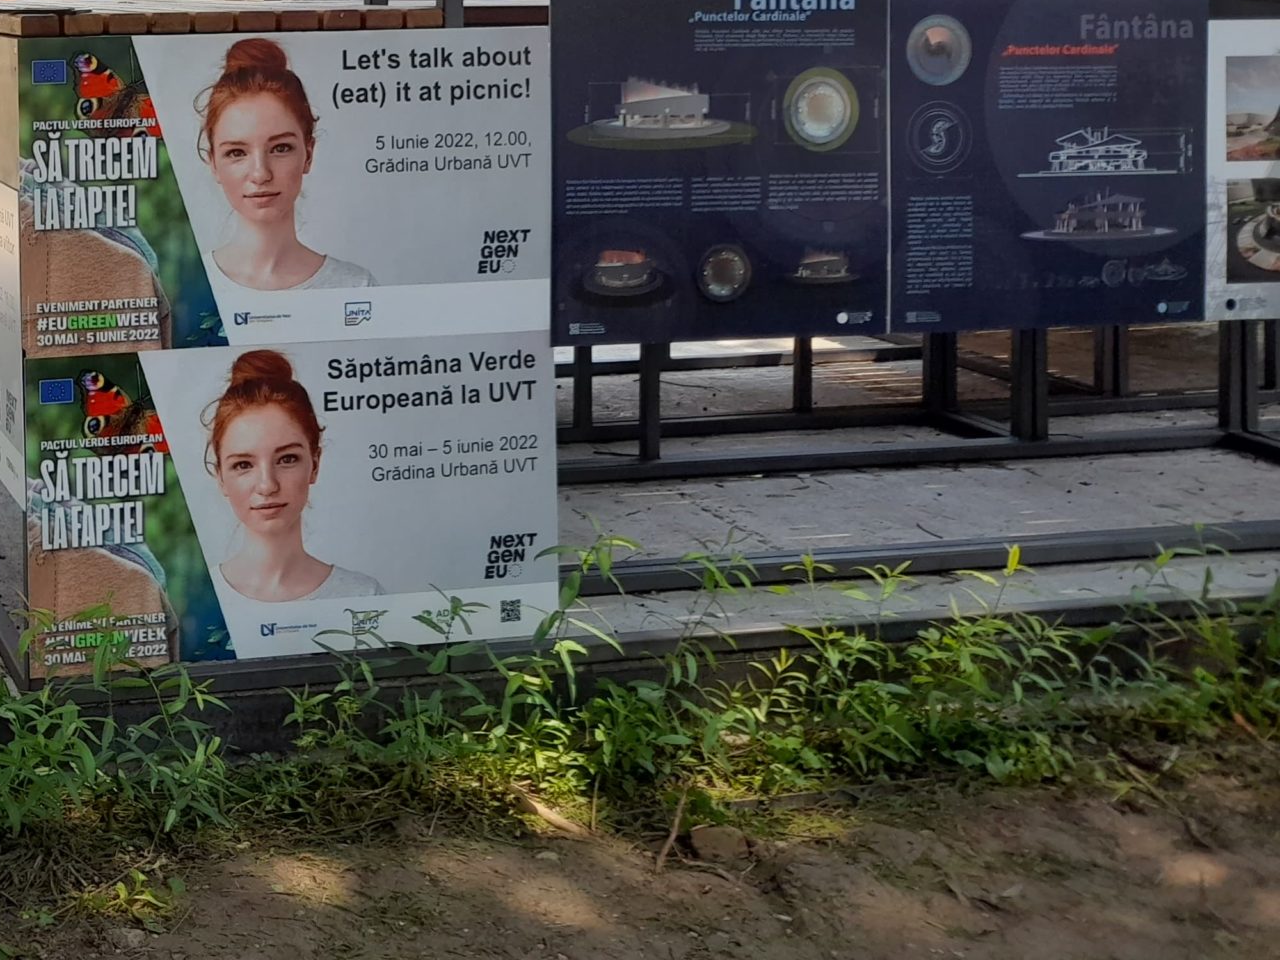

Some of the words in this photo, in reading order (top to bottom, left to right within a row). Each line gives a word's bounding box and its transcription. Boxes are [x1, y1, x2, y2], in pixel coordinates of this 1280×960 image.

[1080, 14, 1194, 40] Fântâna
[342, 49, 400, 70] Let's
[410, 47, 454, 69] talk
[462, 46, 532, 67] about
[332, 82, 386, 109] (eat)
[396, 81, 411, 102] it
[420, 81, 441, 102] at
[450, 78, 530, 106] picnic!
[33, 120, 70, 131] PACTUL
[72, 118, 102, 130] VERDE
[104, 118, 156, 129] EUROPEAN
[376, 136, 385, 150] 5
[392, 134, 429, 150] Iunie
[434, 132, 478, 149] 2022,
[486, 130, 532, 147] 12.00,
[32, 131, 62, 184] SĂ
[65, 136, 158, 182] TRECEM
[366, 157, 428, 174] Grădina
[435, 155, 492, 171] Urbană
[498, 153, 532, 169] UVT
[34, 187, 60, 231] LA
[63, 185, 136, 230] FAPTE!
[478, 260, 501, 274] EU
[37, 300, 102, 314] EVENIMENT
[103, 297, 158, 310] PARTENER
[37, 312, 158, 332] #EUGREENWEEK
[37, 334, 54, 346] 30
[55, 333, 78, 346] MAI
[86, 332, 94, 344] 5
[96, 330, 128, 342] IUNIE
[129, 328, 159, 341] 2022
[328, 354, 461, 382] Săptămâna
[469, 349, 536, 372] Verde
[324, 385, 453, 414] Europeană
[462, 384, 480, 404] la
[489, 380, 537, 402] UVT
[40, 439, 78, 451] PACTUL
[78, 436, 110, 449] VERDE
[111, 434, 162, 446] EUROPEAN
[369, 444, 388, 460] 30
[394, 442, 422, 458] mai
[442, 440, 452, 454] 5
[458, 438, 494, 454] iunie
[499, 434, 538, 451] 2022
[40, 451, 70, 504] SĂ
[72, 452, 164, 500] TRECEM
[372, 464, 435, 482] Grădina
[441, 460, 498, 478] Urbană
[504, 456, 538, 474] UVT
[42, 506, 68, 551] LA
[71, 501, 144, 549] FAPTE!
[484, 565, 508, 580] EU
[138, 644, 167, 656] 2022
